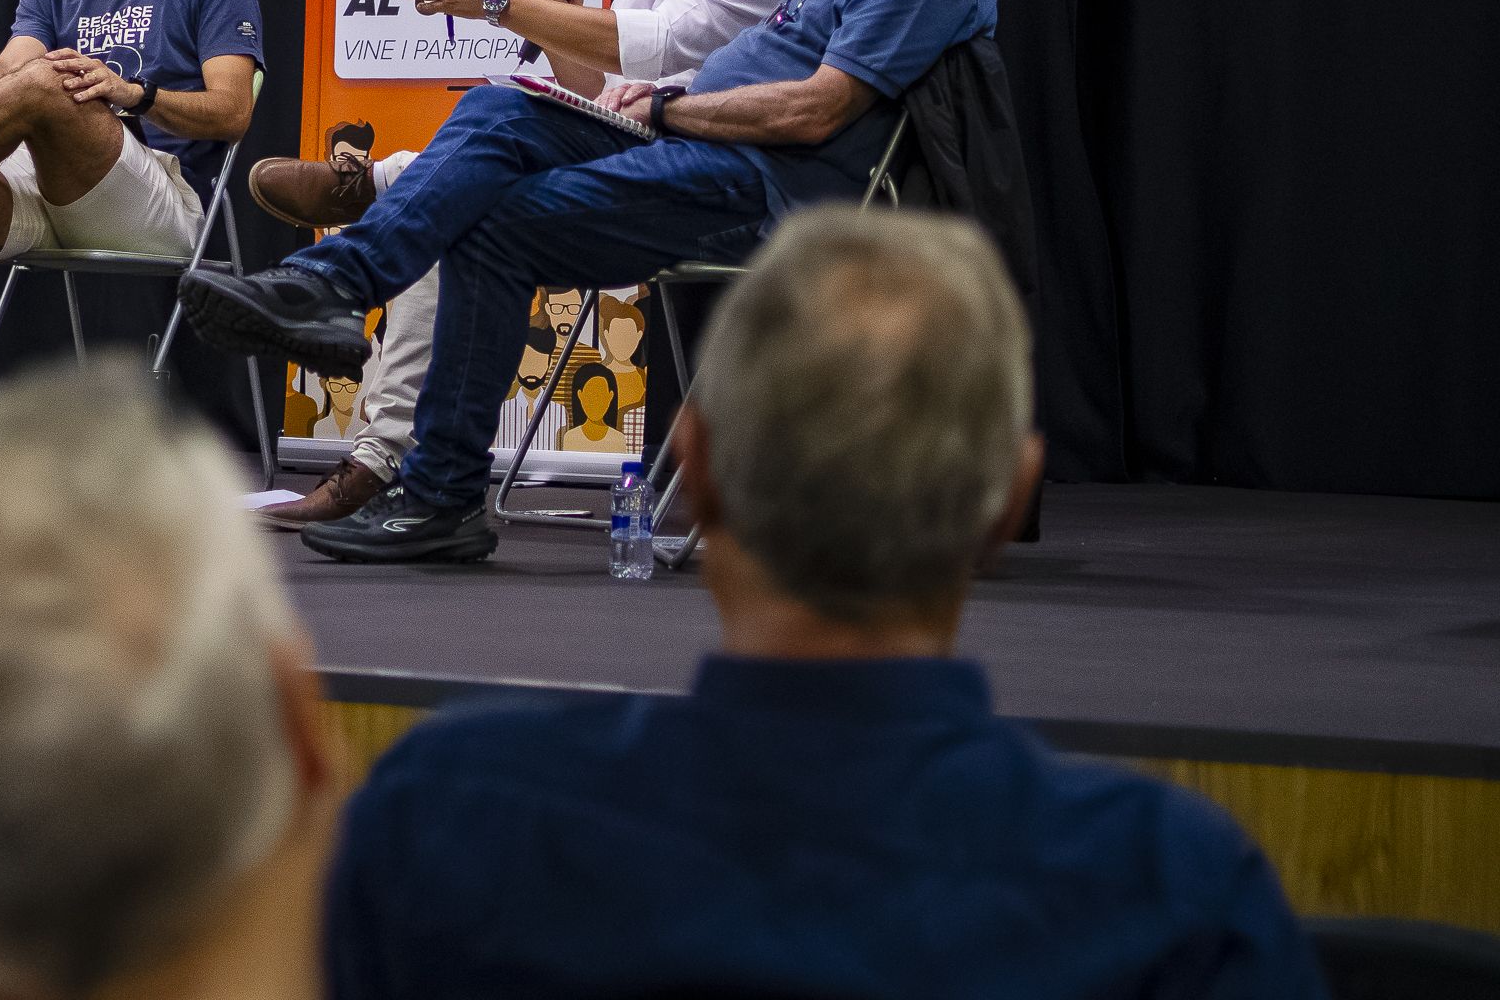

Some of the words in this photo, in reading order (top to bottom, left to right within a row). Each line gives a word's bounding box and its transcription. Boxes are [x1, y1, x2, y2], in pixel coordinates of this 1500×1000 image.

[77, 5, 153, 28] BECAUSE
[132, 18, 151, 28] NO
[345, 39, 396, 60] VINE
[400, 39, 408, 60] I
